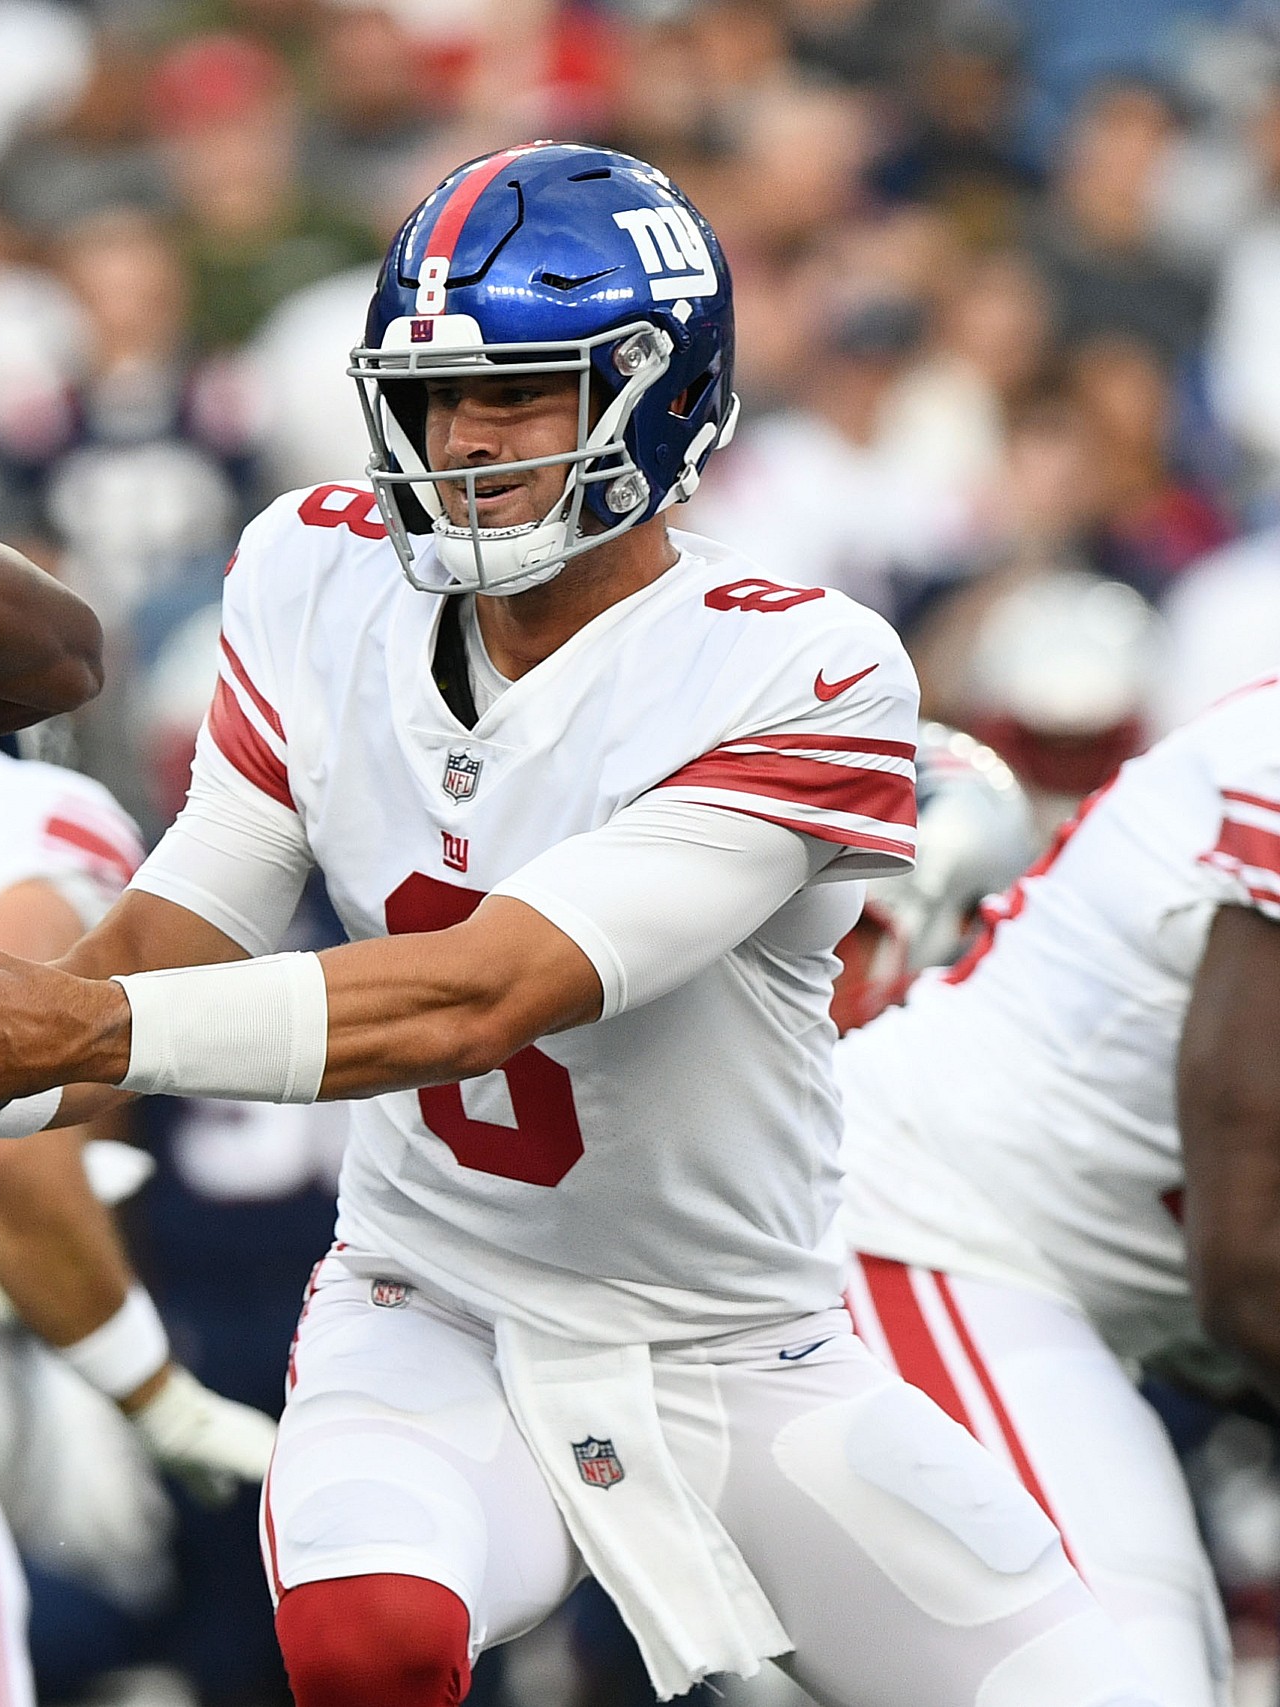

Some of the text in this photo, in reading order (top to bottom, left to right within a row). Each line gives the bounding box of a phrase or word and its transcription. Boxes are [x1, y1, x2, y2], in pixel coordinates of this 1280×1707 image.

[415, 256, 451, 315] 8
[297, 484, 390, 540] 8
[704, 578, 825, 613] 8
[446, 769, 471, 794] NFL
[376, 1284, 404, 1304] NFL
[581, 1459, 621, 1484] NFL
